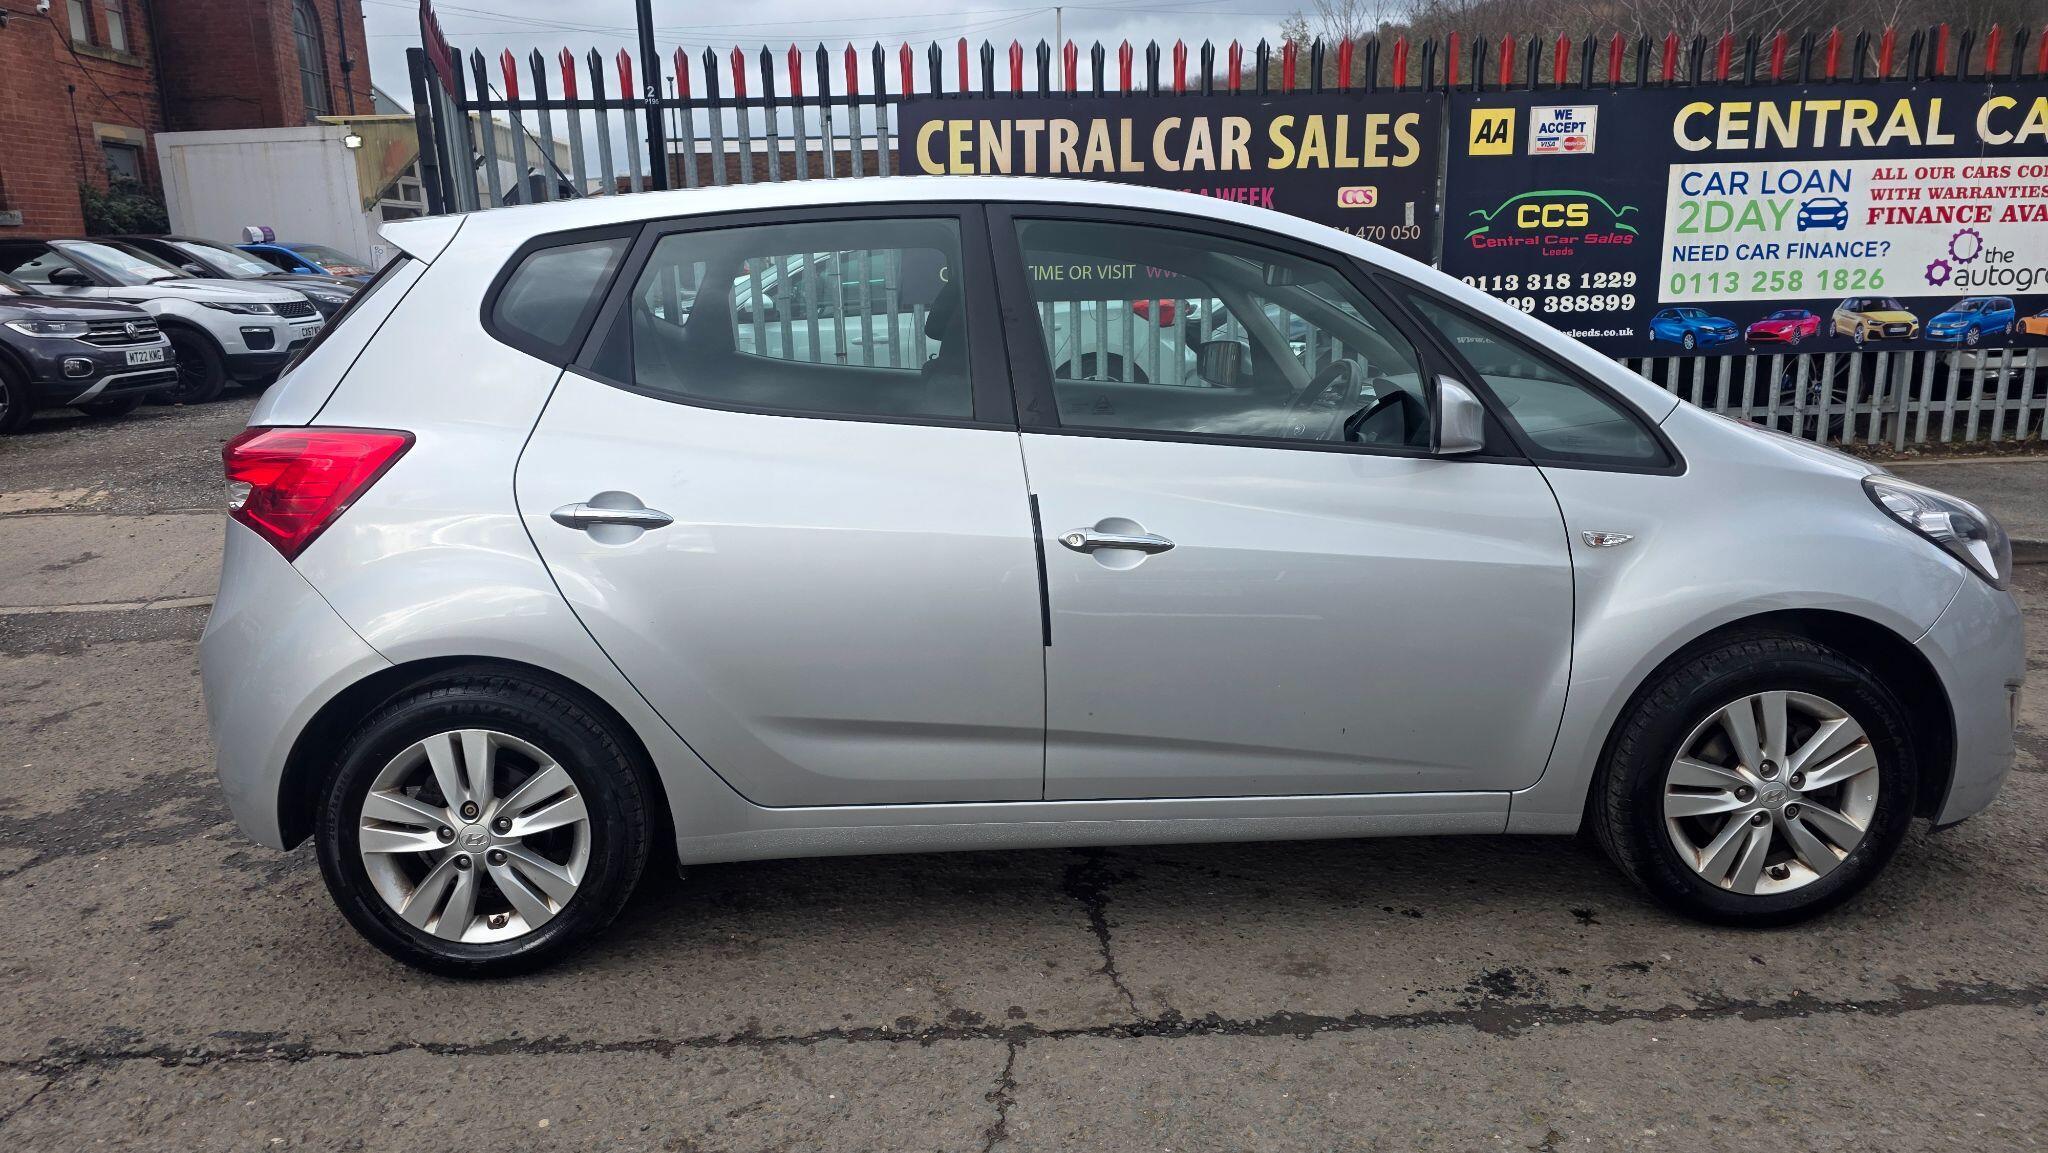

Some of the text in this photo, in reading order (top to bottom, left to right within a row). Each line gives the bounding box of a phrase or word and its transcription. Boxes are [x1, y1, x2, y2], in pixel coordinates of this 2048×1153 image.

[646, 85, 655, 97] 2
[1554, 109, 1573, 120] WE
[1673, 97, 1955, 151] CENTRAL
[1474, 118, 1509, 144] AA
[1538, 121, 1587, 134] ACCEPT
[916, 112, 1421, 176] CENTRAL CAR SALES
[1680, 168, 1852, 197] CAR LOAN
[1871, 167, 1908, 181] ALL
[1914, 166, 1956, 180] OUR
[1961, 165, 2011, 179] CARS
[1215, 186, 1275, 210] WEEK
[1341, 189, 1373, 205] CCS
[1870, 185, 2048, 202] WITH WARRANTIES
[1517, 203, 1589, 229] CCS
[1676, 198, 1795, 234] 2DAY
[1865, 204, 1993, 226] FINANCE
[1354, 225, 1386, 241] 470
[1390, 225, 1421, 240] 050
[1471, 232, 1634, 249] Central Car Sales
[1542, 247, 1574, 256] Leeds
[1672, 240, 1891, 263] NEED CAR FINANCE?
[1984, 246, 2015, 264] the
[1069, 265, 1092, 280] OR
[1096, 264, 1137, 280] VISIT
[1526, 273, 1571, 291] 318
[1580, 271, 1637, 288] 1229
[1670, 268, 1885, 295] 0113 258 1826
[1543, 293, 1636, 314] 388899
